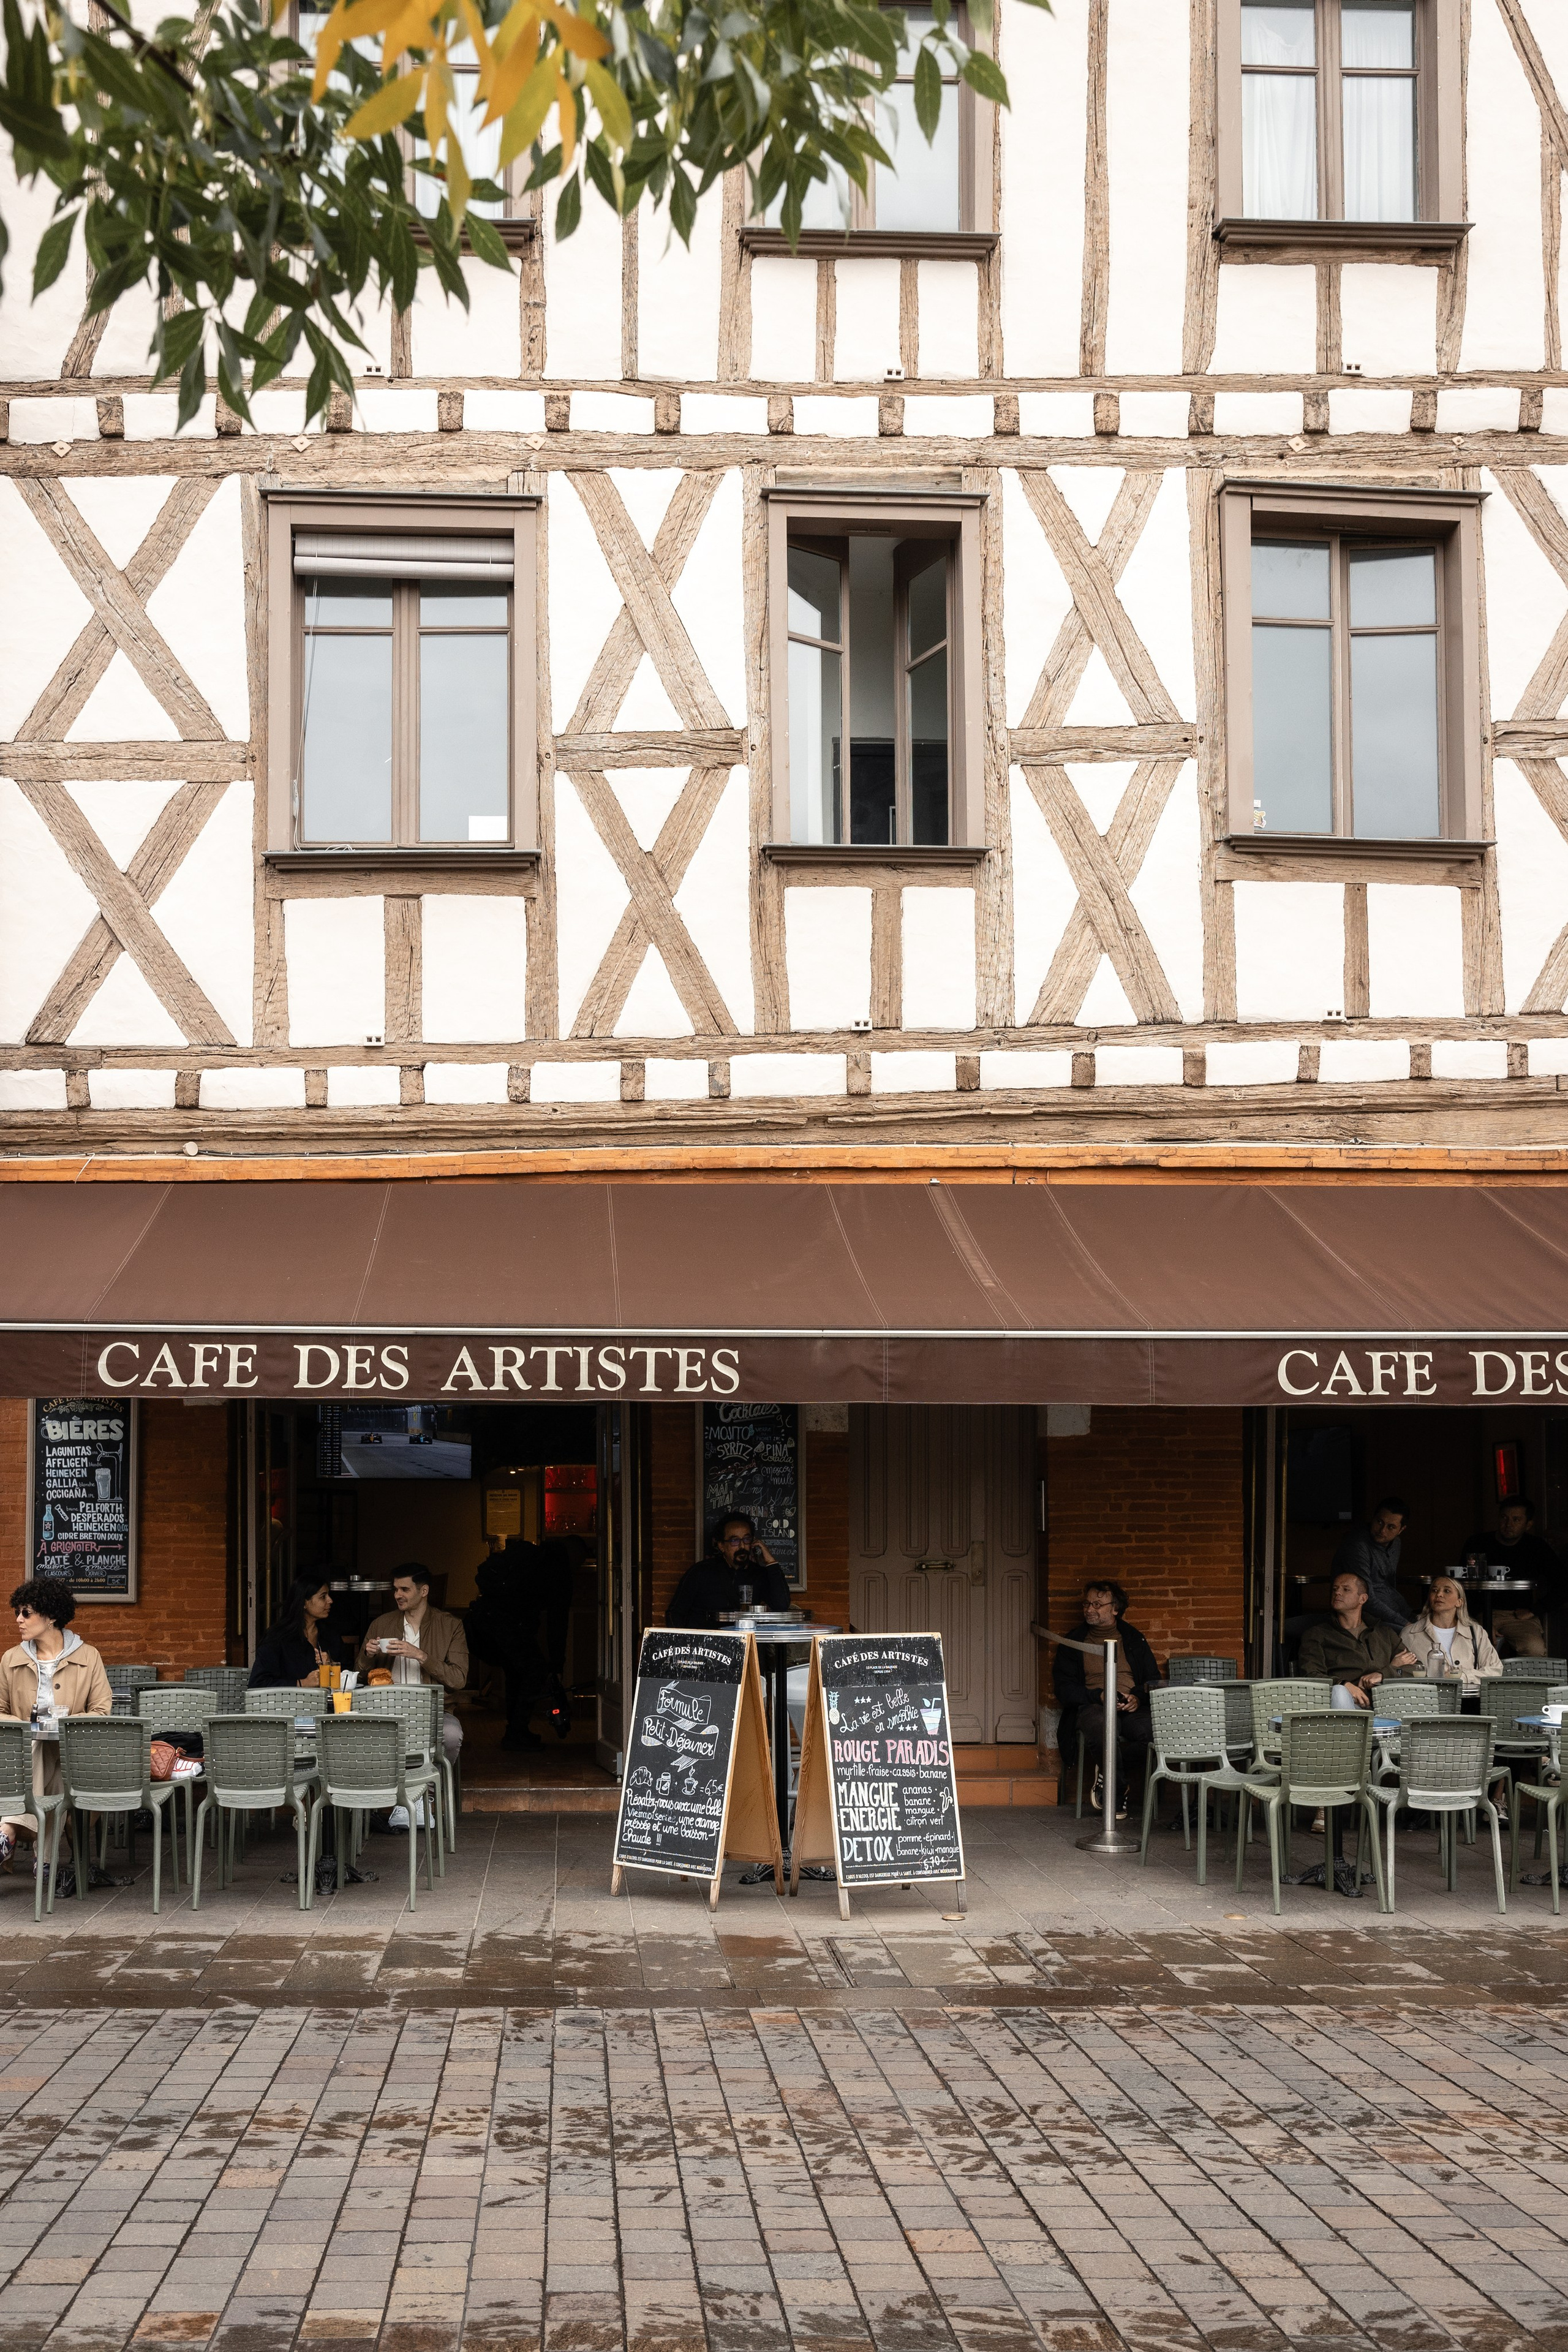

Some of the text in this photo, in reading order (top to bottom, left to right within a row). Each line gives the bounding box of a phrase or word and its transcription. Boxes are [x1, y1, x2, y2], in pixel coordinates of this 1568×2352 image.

[97, 1341, 739, 1395] CAFE DES ARTISTES
[1277, 1349, 1437, 1396] CAFE
[709, 1427, 750, 1440] MOJITO
[46, 1446, 91, 1457] LAGUNITAS
[717, 1441, 788, 1460] SPRITZ PIÑA
[45, 1457, 88, 1468] AFFLIGEM
[46, 1468, 87, 1477] HEINEKEN
[46, 1479, 78, 1488] GALLIA
[80, 1501, 122, 1513] PELFORTH
[71, 1513, 124, 1523] DESPERADOS
[766, 1519, 789, 1528] GOLD
[72, 1523, 116, 1531] HEINEKEN
[761, 1528, 795, 1538] ISLAND
[51, 1541, 99, 1553] GRIGNOTER
[75, 1553, 85, 1566] &
[87, 1555, 126, 1566] PLANCHE
[652, 1645, 732, 1665] CAFÉ DES ARTISTES
[834, 1651, 929, 1669] CAFÉ DES ARTISTES
[660, 1689, 704, 1722] Formule
[840, 1688, 910, 1733] La vie est belle
[875, 1705, 919, 1733] en smoothie
[645, 1718, 714, 1756] Petit-Déjeuner
[834, 1740, 949, 1766] ROUGE PARADIS
[837, 1763, 948, 1781] myrtille fraise cassis banane
[837, 1782, 932, 1807] MANGUE ananas
[903, 1795, 931, 1806] banane
[706, 1797, 722, 1816] belle
[840, 1807, 935, 1831] ENERGIE mangue
[907, 1814, 944, 1826] citron vert
[622, 1828, 651, 1844] chaude
[652, 1821, 662, 1831] et
[663, 1826, 679, 1835] une
[680, 1823, 708, 1841] boisson
[842, 1836, 894, 1862] DETOX
[898, 1836, 922, 1849] pomme
[925, 1830, 951, 1845] épinard
[896, 1843, 959, 1858] banane kiwi mangue
